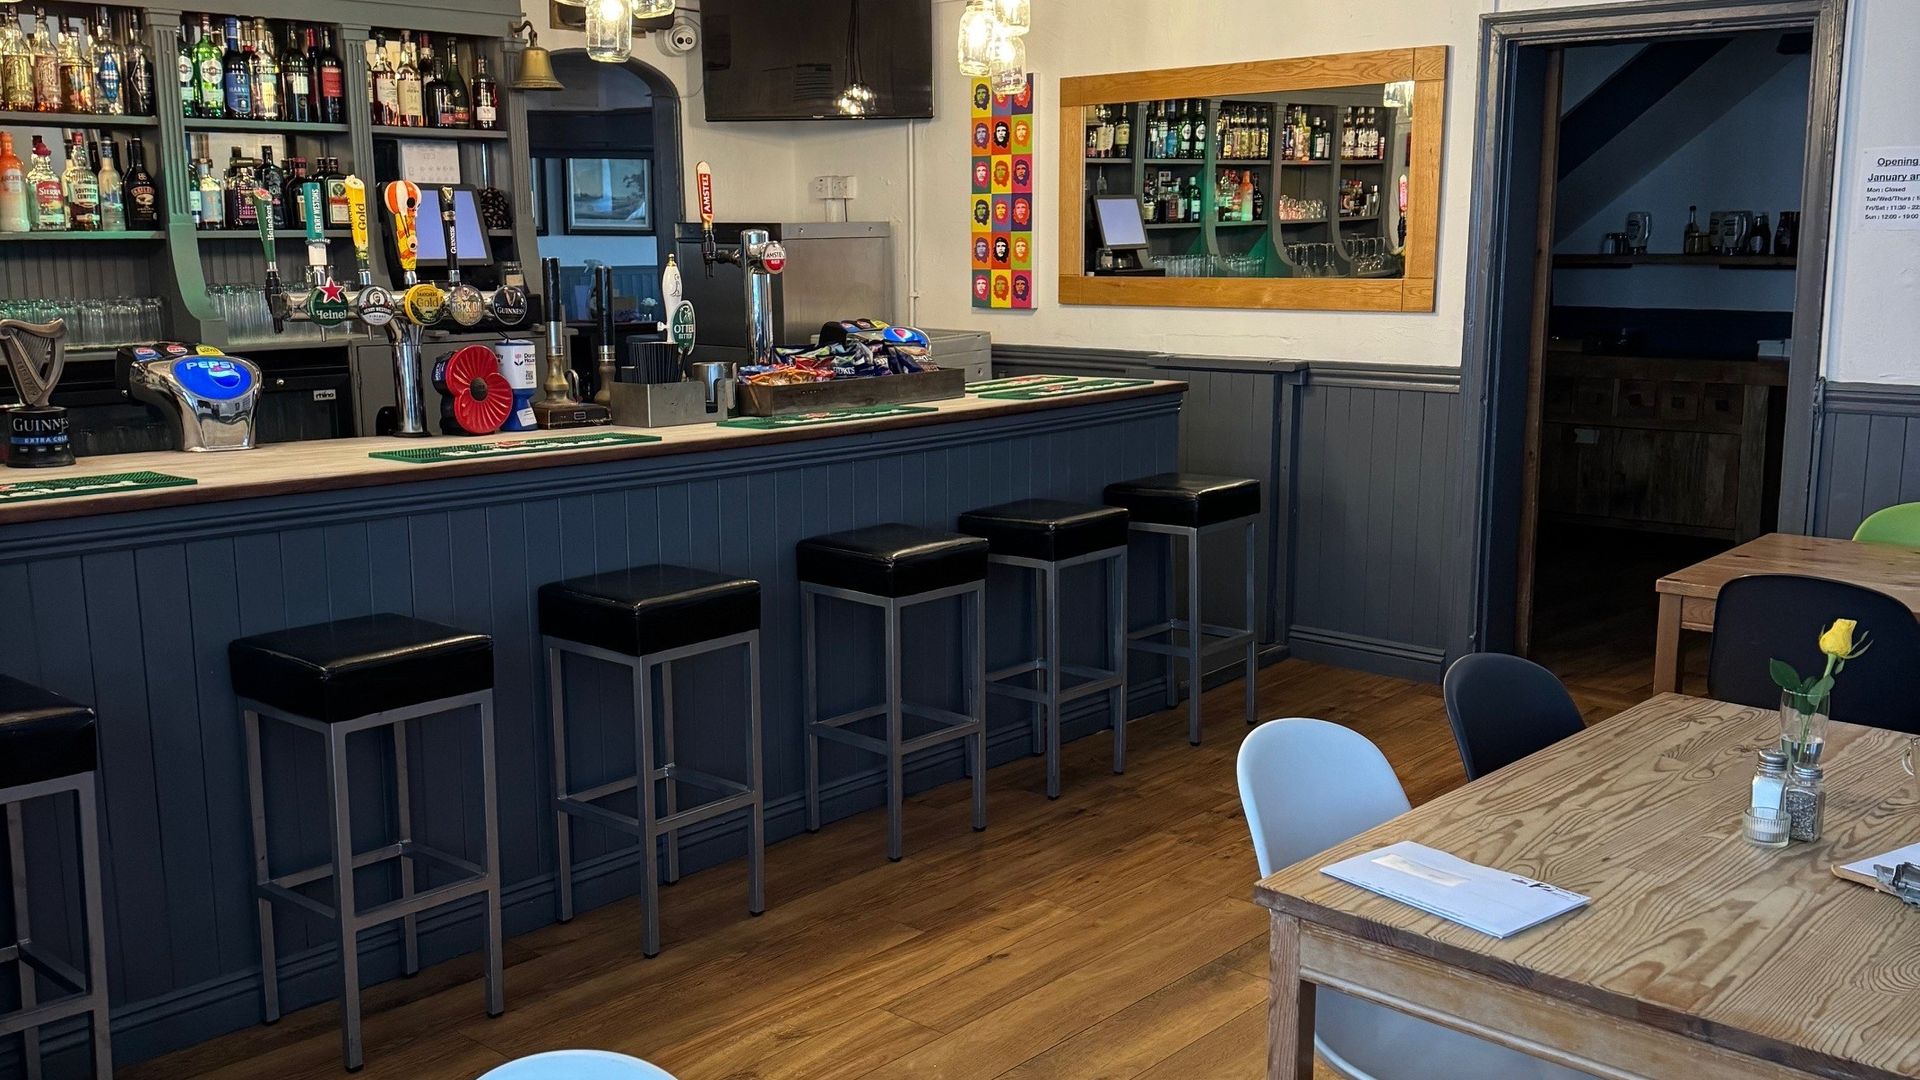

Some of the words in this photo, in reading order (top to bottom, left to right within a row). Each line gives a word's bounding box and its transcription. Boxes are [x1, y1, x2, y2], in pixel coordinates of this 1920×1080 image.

[1878, 157, 1919, 166] Opening
[1867, 173, 1907, 182] January
[702, 174, 711, 213] AMSTEL
[266, 204, 275, 241] Heineken
[314, 214, 322, 234] HENRY
[356, 203, 367, 231] Gold
[416, 297, 439, 308] Gold
[185, 361, 236, 370] PEPSI
